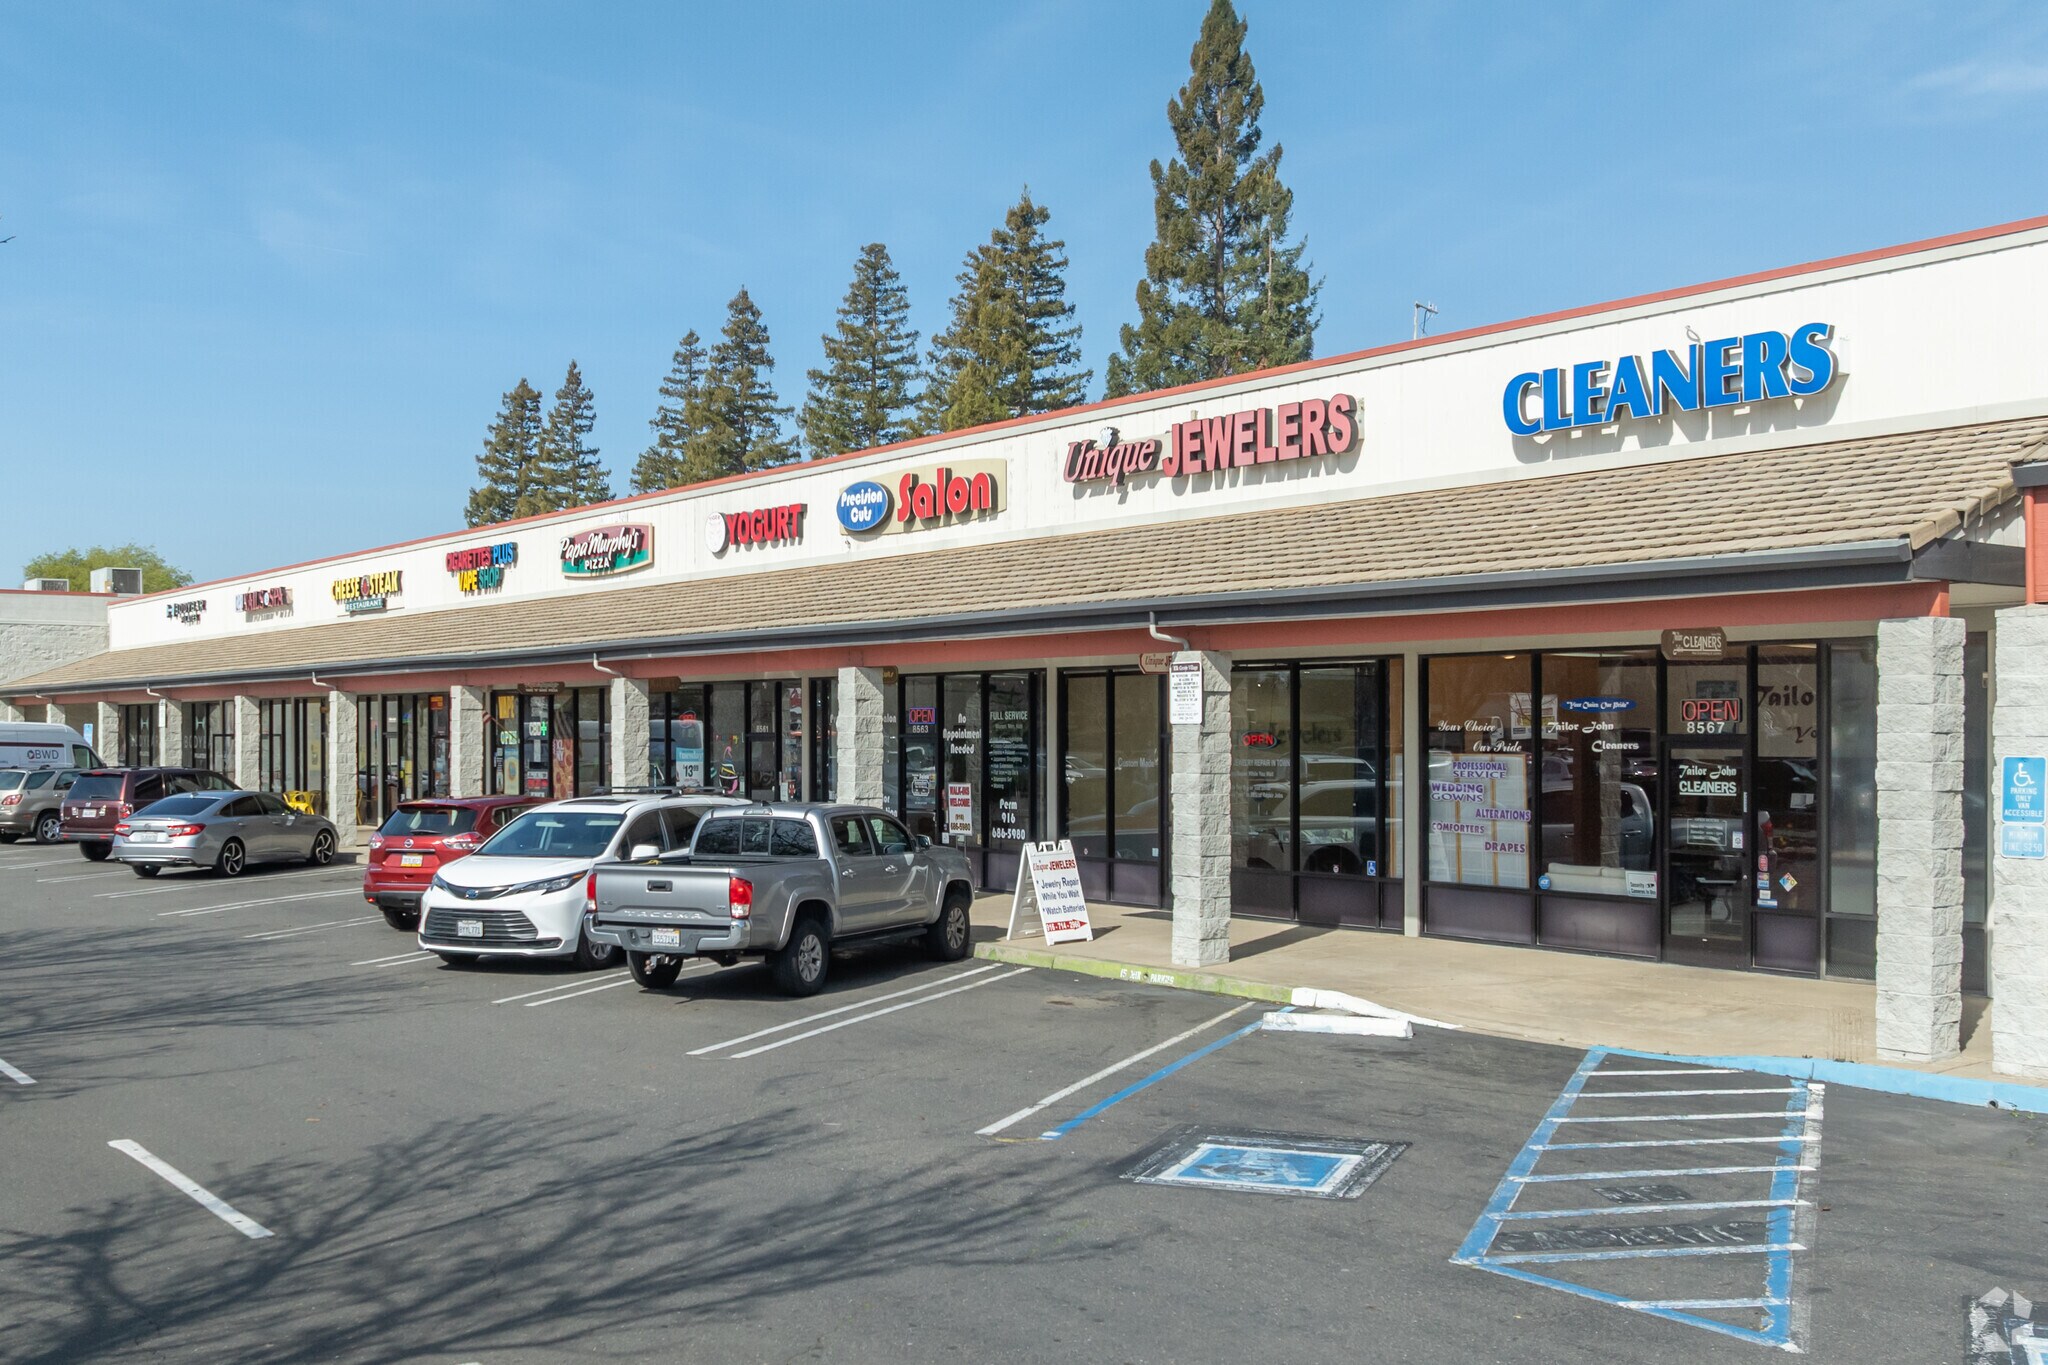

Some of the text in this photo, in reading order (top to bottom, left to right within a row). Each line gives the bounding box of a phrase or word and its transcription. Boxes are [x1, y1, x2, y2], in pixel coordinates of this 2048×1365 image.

[1504, 322, 1834, 436] CLEANERS
[1063, 393, 1354, 488] Unique JEWELERS
[840, 487, 883, 507] Precision
[897, 467, 992, 523] Salon
[850, 505, 872, 523] Cuts
[726, 503, 802, 545] YOGURT
[561, 527, 639, 565] Papa Murphy's
[446, 542, 514, 571] CIGARETTES PLUS
[584, 557, 610, 570] PIZZA
[331, 570, 399, 601] CHEESE STEAK
[458, 567, 501, 592] VAPE SHOP
[345, 599, 384, 611] RESTAURANT
[1683, 635, 1722, 650] CLEANERS
[1758, 685, 1815, 707] Tailo
[910, 709, 935, 722] OPEN
[990, 710, 1028, 720] FULL SERVICE
[1682, 700, 1739, 721] OPEN
[958, 713, 967, 723] No
[912, 725, 929, 733] 8563
[1437, 719, 1496, 732] Your Choice
[1547, 721, 1614, 734] Tailor John
[1686, 721, 1725, 733] 8567
[942, 728, 982, 741] Appointment
[1242, 733, 1274, 746] OPEN
[950, 743, 975, 754] Needed
[1472, 740, 1523, 753] Our Pride
[1590, 740, 1640, 753] Cleaners
[1452, 761, 1507, 771] PROFESSIONAL
[1678, 764, 1737, 780] Tailor John
[1453, 770, 1506, 779] SERVICE
[949, 786, 970, 795] WALK-INS
[1431, 782, 1484, 793] WEDDING
[1679, 780, 1738, 795] CLEANERS
[2010, 787, 2038, 795] PARKING
[949, 798, 970, 807] WELCOME
[999, 798, 1017, 809] Perm
[1431, 792, 1484, 802] GOWNS
[1001, 812, 1016, 823] 916
[1475, 808, 1532, 820] ALTERATIONS
[2004, 809, 2044, 817] ACCESSIBLE
[991, 827, 1026, 840] 686-5980
[1432, 822, 1485, 834] COMFORTERS
[1484, 841, 1526, 853] DRAPES
[2004, 841, 2021, 851] FINE
[1032, 859, 1076, 872] Unique JEWELERS
[1041, 876, 1080, 890] Jewelry Repair
[1042, 889, 1080, 902] While You Wait
[623, 909, 702, 920] TACOMA
[1045, 903, 1086, 915] Watch Batteries
